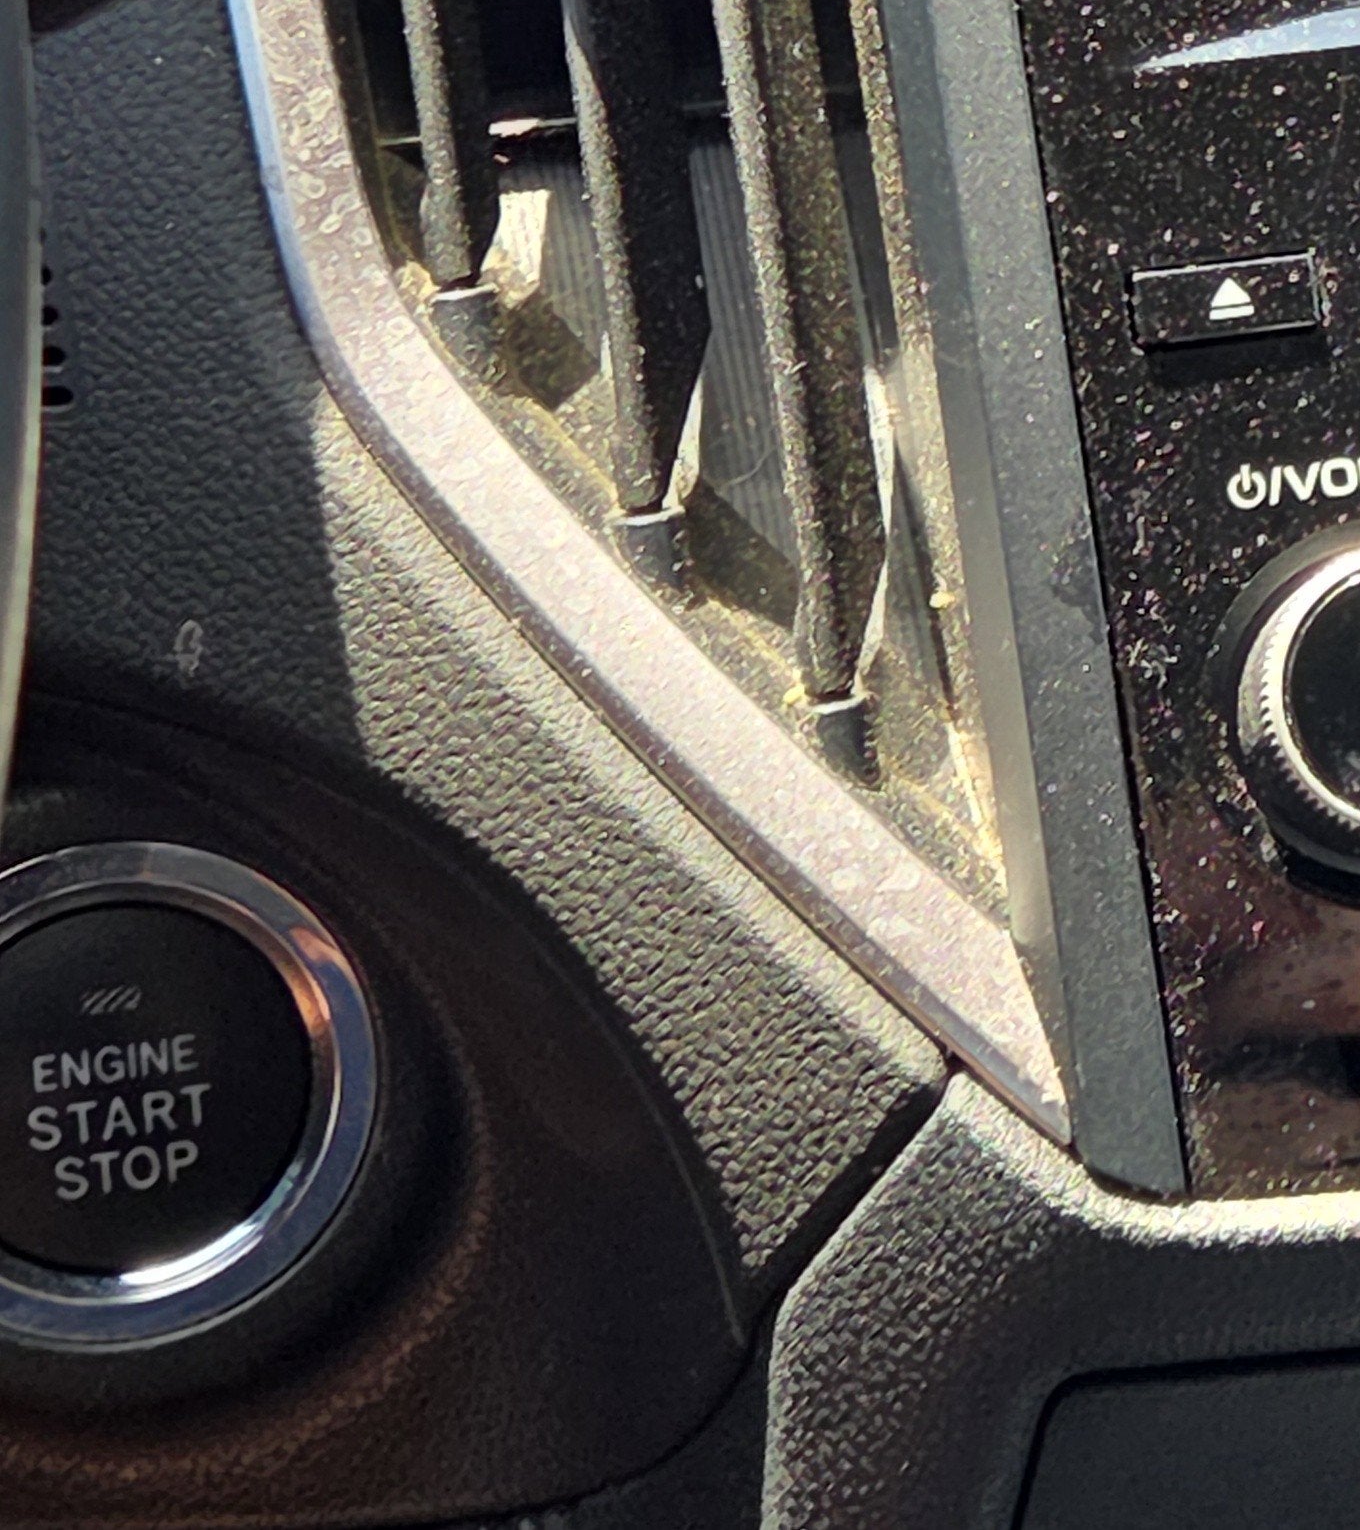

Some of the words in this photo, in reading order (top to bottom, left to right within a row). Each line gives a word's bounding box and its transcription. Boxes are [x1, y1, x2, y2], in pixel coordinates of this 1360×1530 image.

[32, 1033, 199, 1094] ENGINE
[27, 1083, 211, 1152] START
[54, 1139, 199, 1201] STOP
